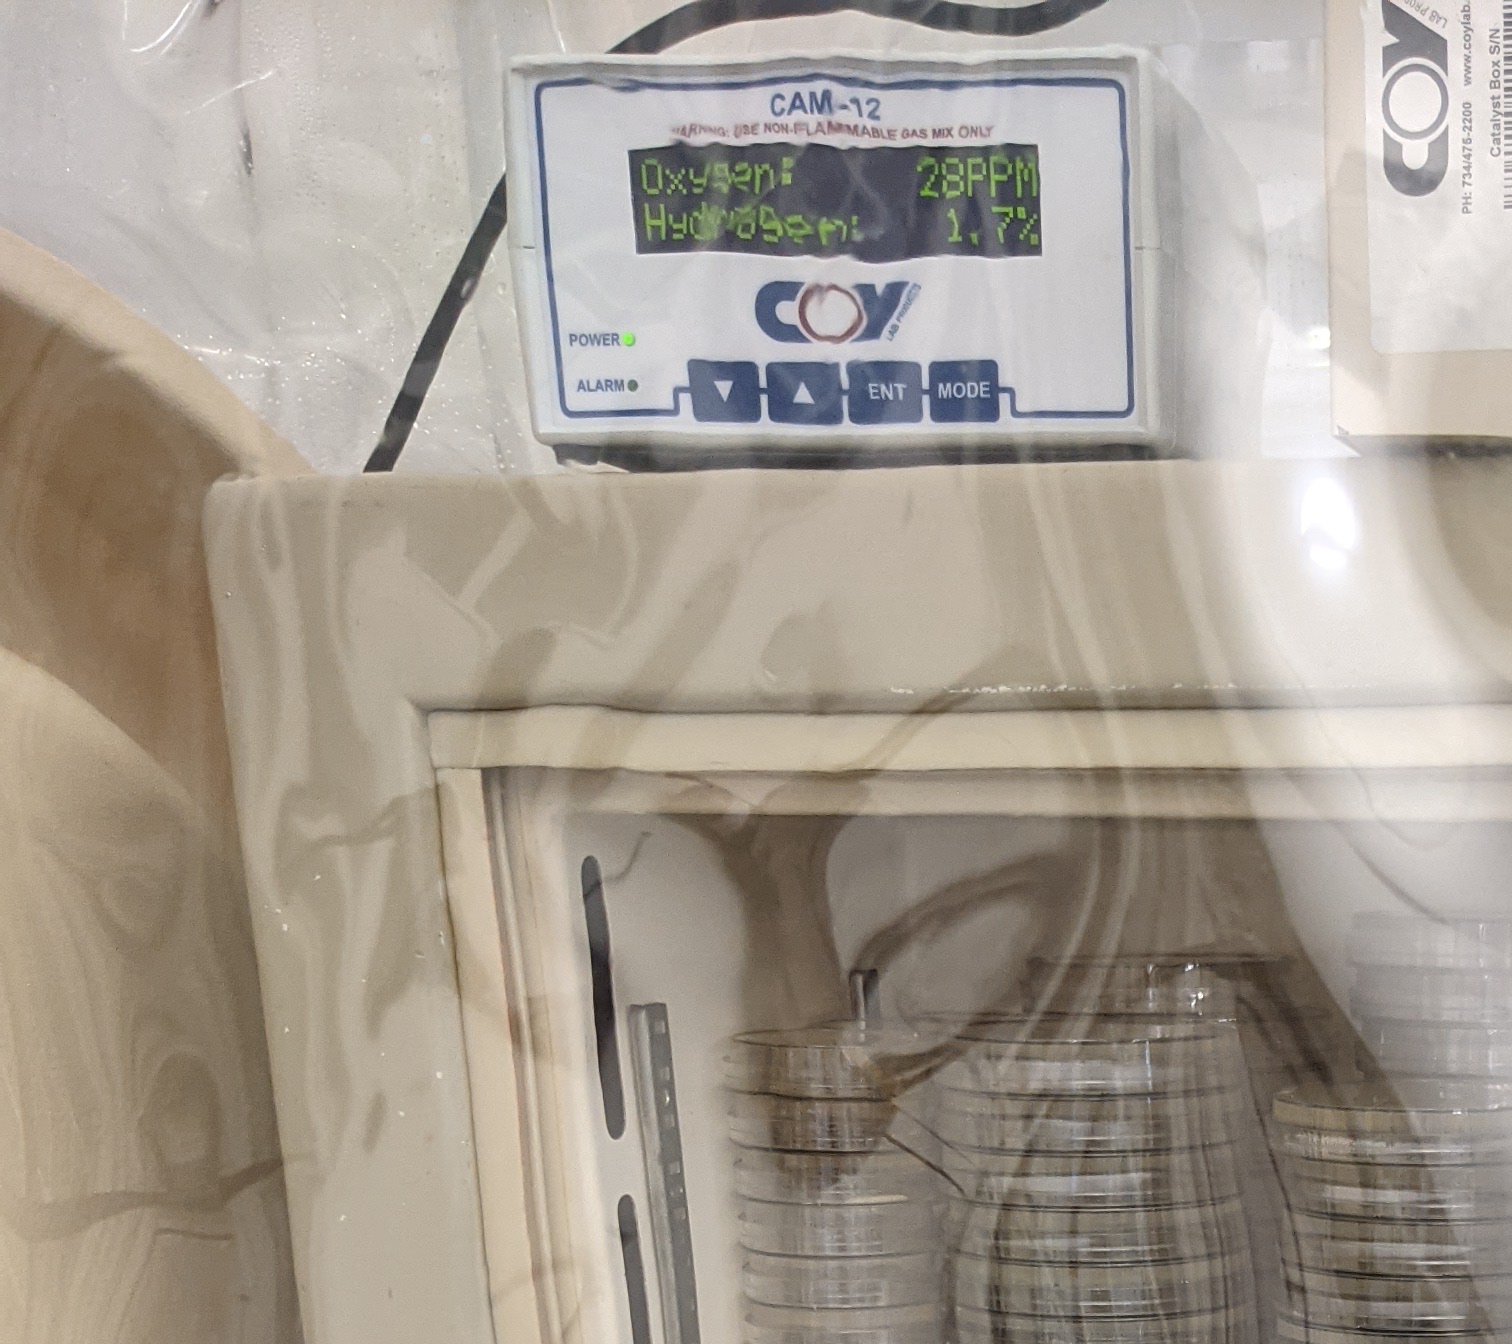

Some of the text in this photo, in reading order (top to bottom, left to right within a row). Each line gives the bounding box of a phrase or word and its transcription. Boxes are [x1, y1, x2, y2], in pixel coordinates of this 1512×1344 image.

[1430, 10, 1448, 28] LAB
[769, 89, 881, 121] CAM-12
[1381, 0, 1449, 197] COY
[1489, 28, 1504, 158] Catalyst Box S/N
[733, 122, 759, 139] USE
[901, 127, 928, 140] GAS
[931, 126, 954, 139] MIX
[957, 125, 995, 139] ONLY
[1461, 101, 1474, 188] 734/475-2200
[640, 156, 1039, 199] Oxygen: 28PPM
[1461, 191, 1473, 215] PH:
[643, 202, 864, 247] Hydrogen:
[754, 280, 910, 345] COY
[568, 332, 621, 348] POWER
[576, 377, 626, 394] ALARM
[867, 383, 906, 402] ENT
[937, 382, 991, 400] MODE
